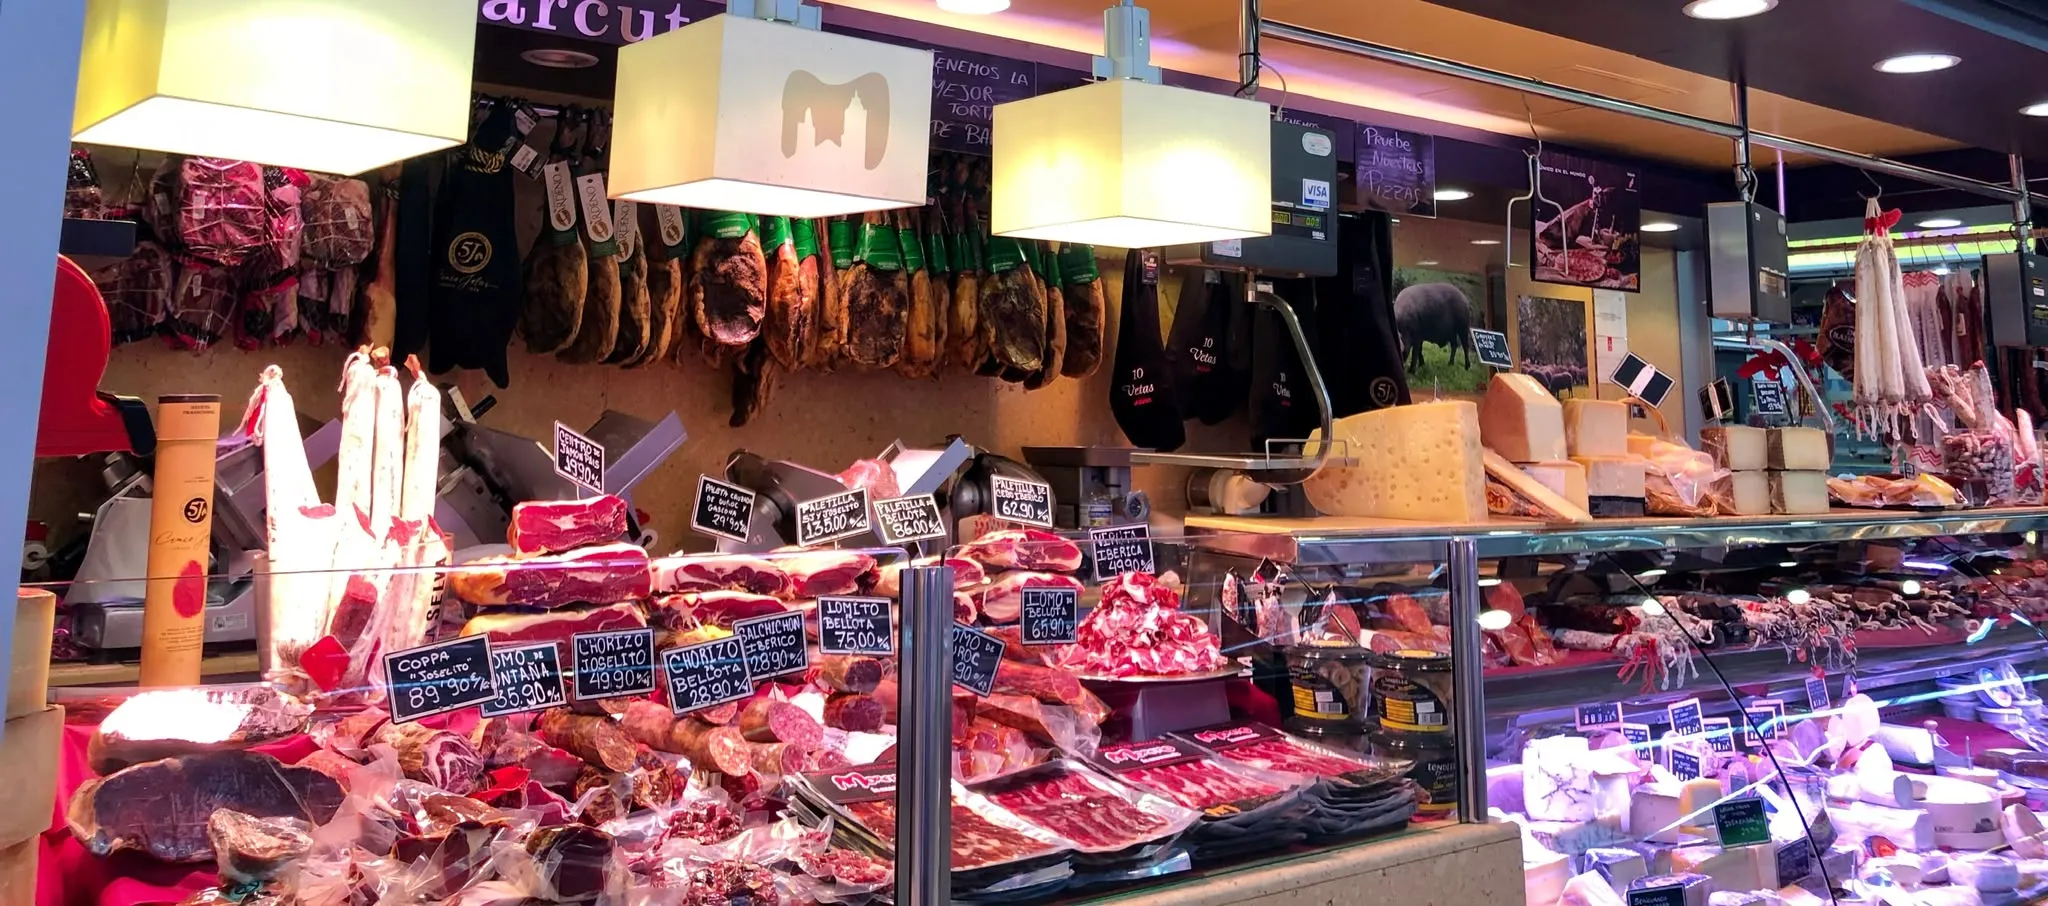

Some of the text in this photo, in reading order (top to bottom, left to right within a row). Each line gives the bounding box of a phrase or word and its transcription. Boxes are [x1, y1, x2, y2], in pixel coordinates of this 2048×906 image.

[1011, 71, 1029, 86] LA
[965, 123, 992, 145] BA
[1307, 185, 1328, 198] VISA
[1203, 337, 1213, 348] 10
[1190, 347, 1217, 365] Vetas
[1132, 368, 1144, 380] 10
[1122, 383, 1154, 397] Vetas
[559, 430, 592, 455] CENTRO
[995, 479, 1047, 495] PALETILLA DE
[800, 493, 856, 514] PALETILLA
[822, 501, 860, 519] JOSELITO
[876, 498, 927, 515] PALETILLA
[880, 508, 928, 525] BELLOTA
[1097, 544, 1143, 562] IBERICA
[1026, 591, 1063, 608] LOMO
[826, 601, 880, 617] LOMITO
[1024, 606, 1068, 618] BELLOTA
[738, 615, 801, 644] SALCHICHON
[823, 616, 875, 630] BELLOTA
[578, 633, 644, 656] CHORIZO
[745, 634, 797, 655] IBERICO
[397, 650, 451, 673] COPPA
[492, 649, 544, 670] OMO DE
[580, 648, 647, 674] JOSELITO
[669, 641, 739, 674] CHORIZO
[672, 663, 742, 693] BELLOTA
